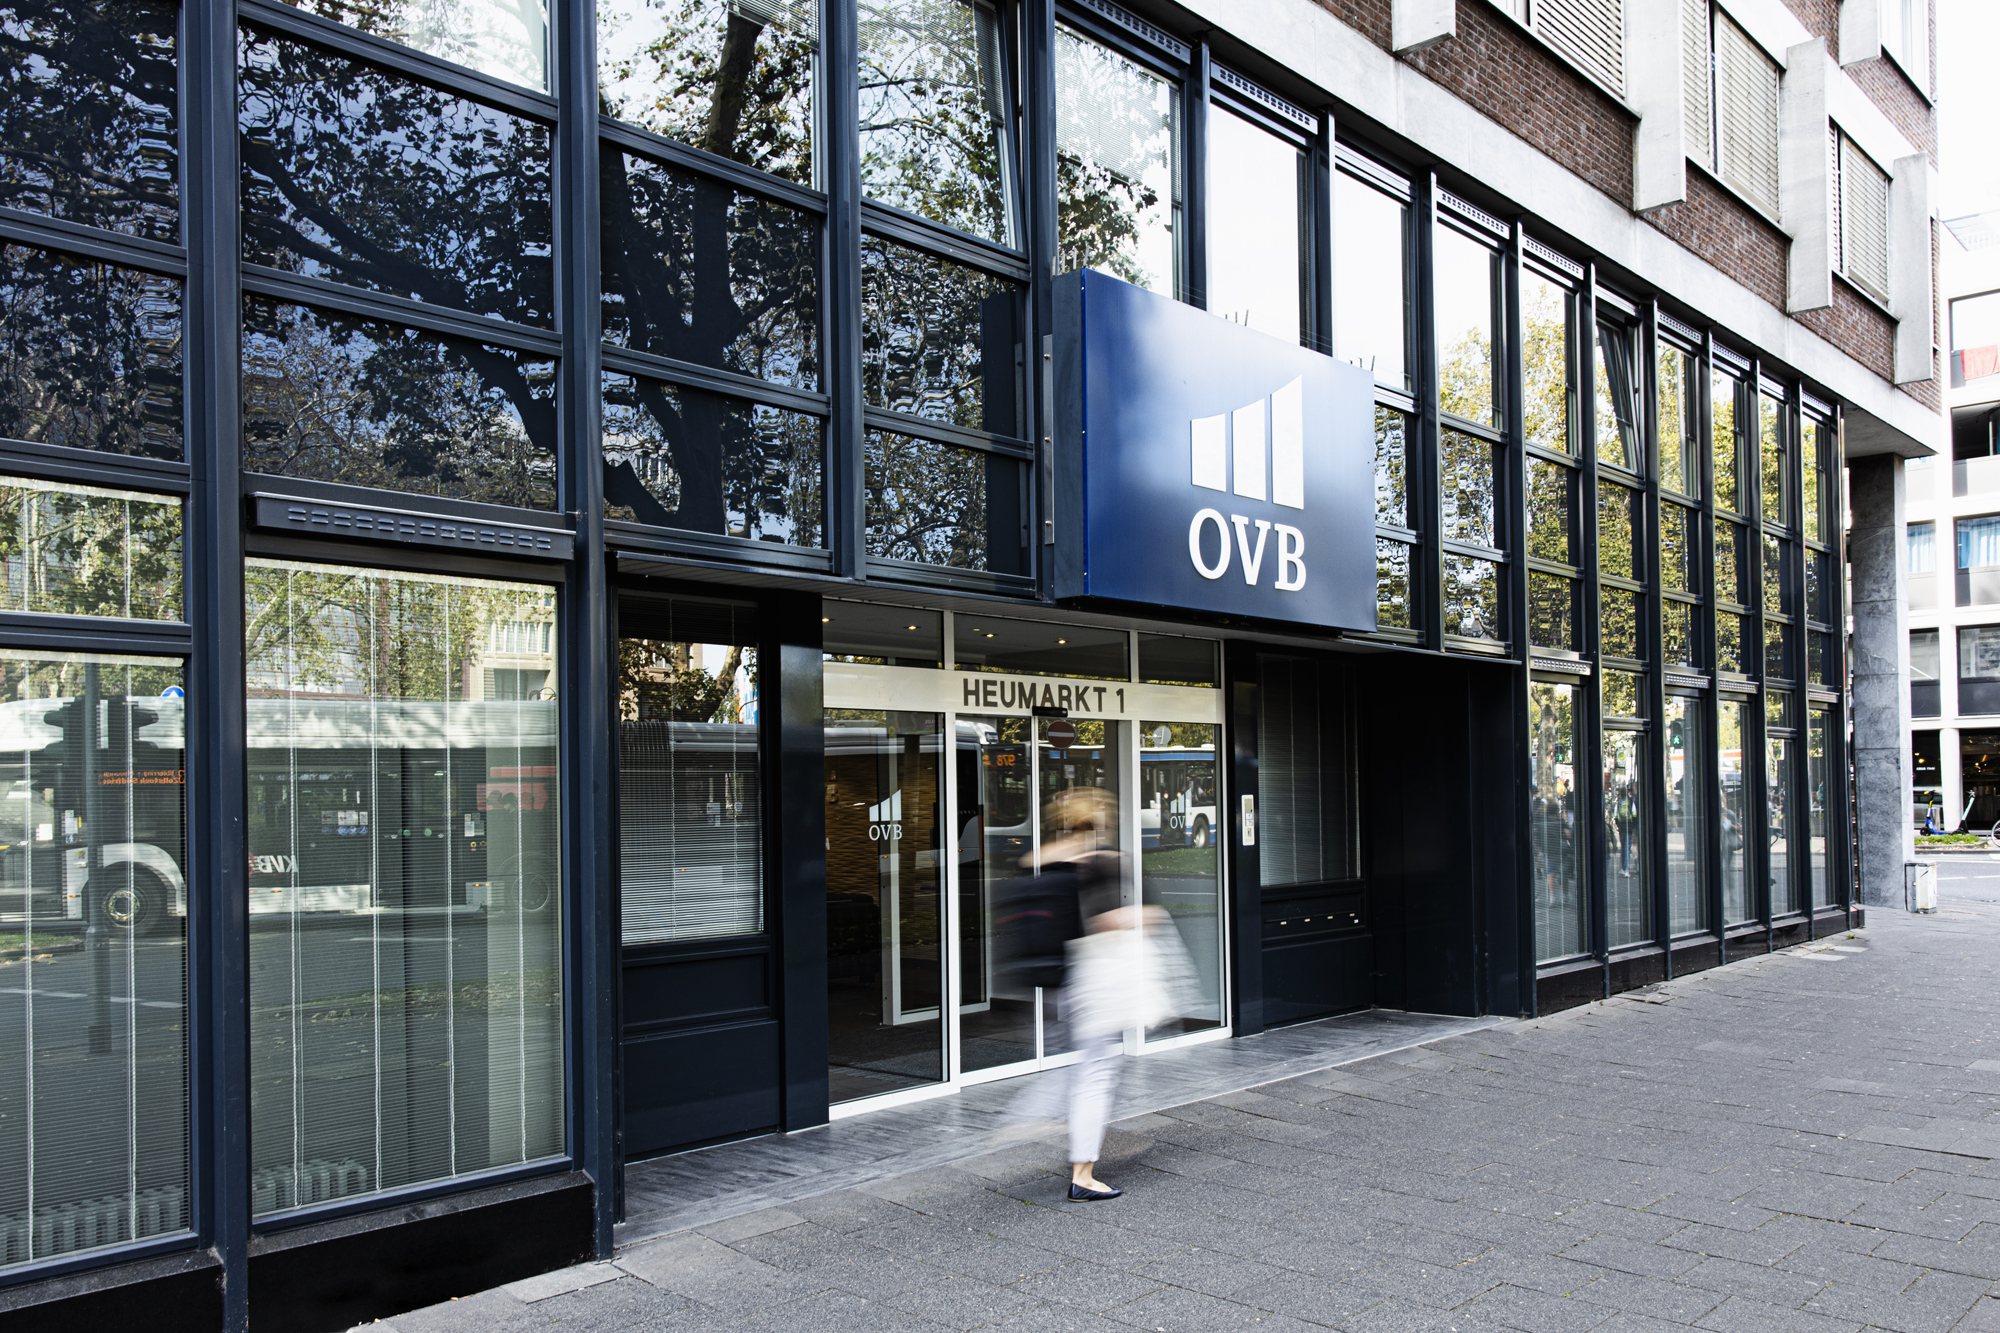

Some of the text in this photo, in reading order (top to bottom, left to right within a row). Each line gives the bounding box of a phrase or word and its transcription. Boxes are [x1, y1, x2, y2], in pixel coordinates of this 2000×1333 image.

[1188, 508, 1307, 592] OVB
[963, 678, 1125, 713] HEUMARKT 1
[868, 824, 903, 841] OVB
[1170, 815, 1192, 829] OV
